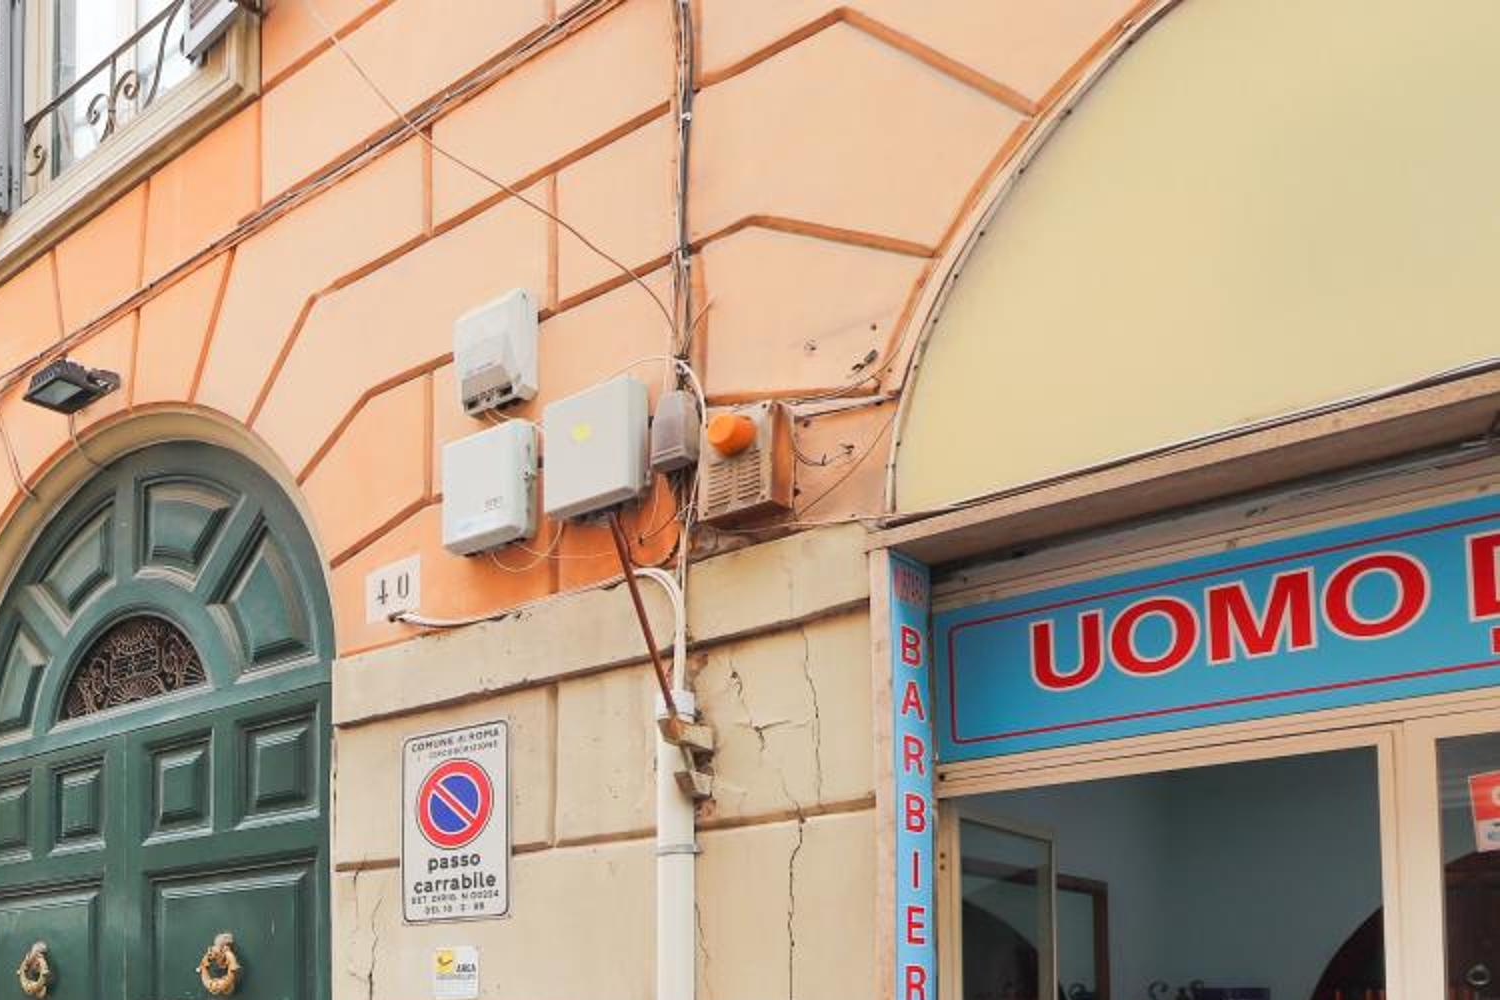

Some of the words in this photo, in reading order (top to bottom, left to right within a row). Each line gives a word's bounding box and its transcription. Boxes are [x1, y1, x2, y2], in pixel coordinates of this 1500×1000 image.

[1030, 551, 1431, 692] UOMO
[411, 738, 454, 753] COMUNE
[468, 728, 499, 741] ROMA
[427, 854, 481, 874] passo
[413, 871, 496, 894] carrabile
